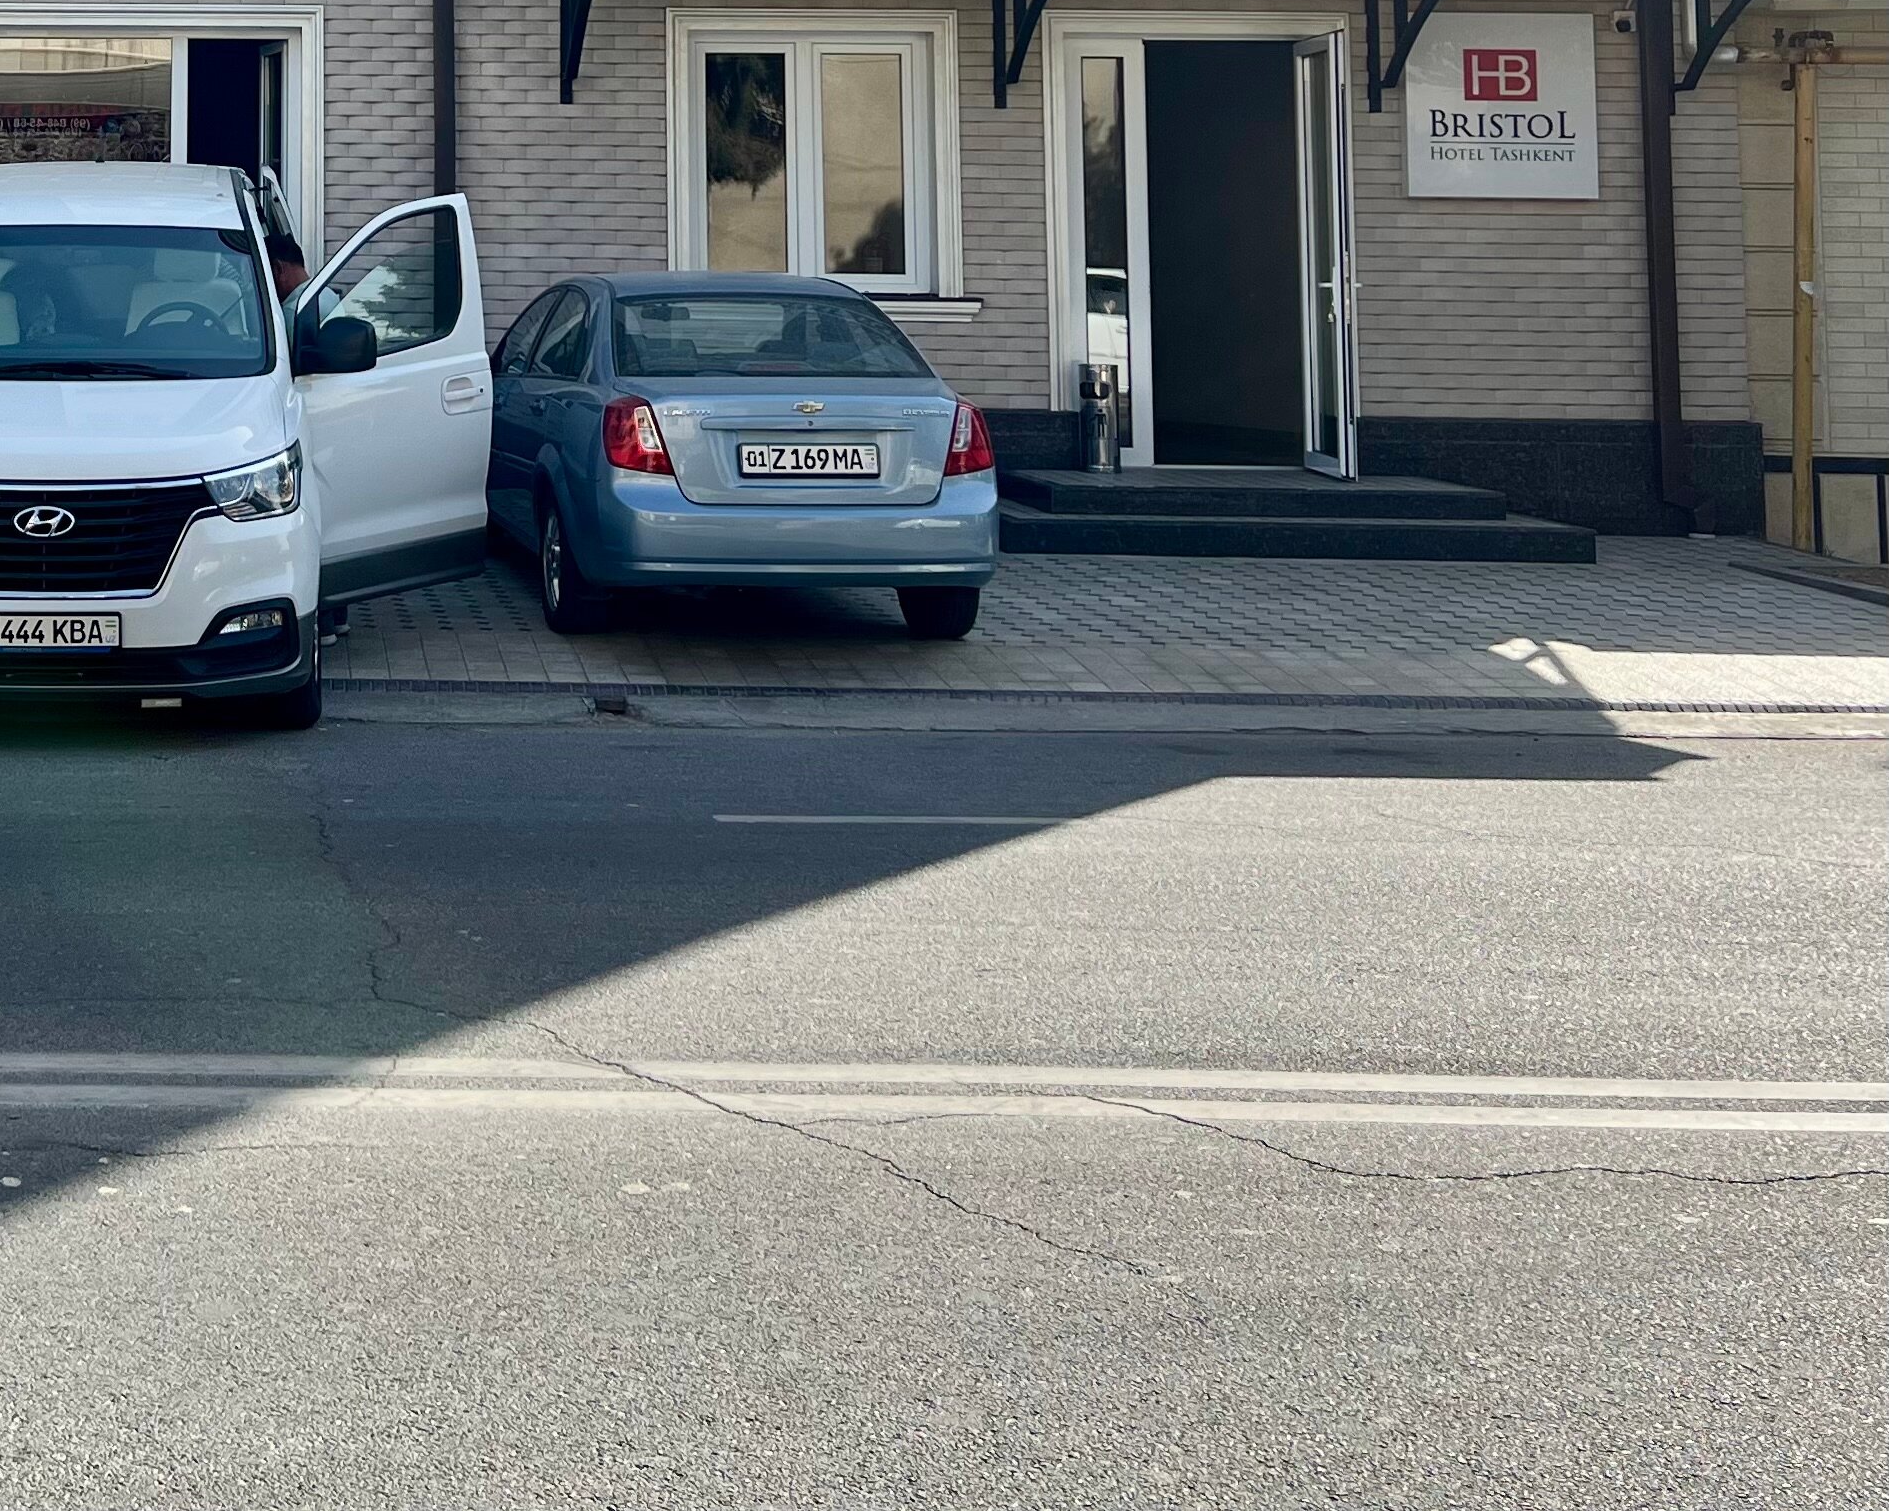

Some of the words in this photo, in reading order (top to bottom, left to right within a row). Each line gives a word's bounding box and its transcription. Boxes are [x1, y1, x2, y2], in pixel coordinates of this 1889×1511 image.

[1470, 54, 1532, 96] HB
[1429, 108, 1577, 140] BRISTOL
[1430, 146, 1485, 161] HOTEL
[1489, 146, 1577, 162] TASHKENT
[746, 450, 768, 468] 01
[771, 448, 787, 470] Z
[790, 448, 830, 470] 169
[832, 448, 864, 470] MA
[0, 619, 45, 644] 444
[52, 619, 104, 644] KBA
